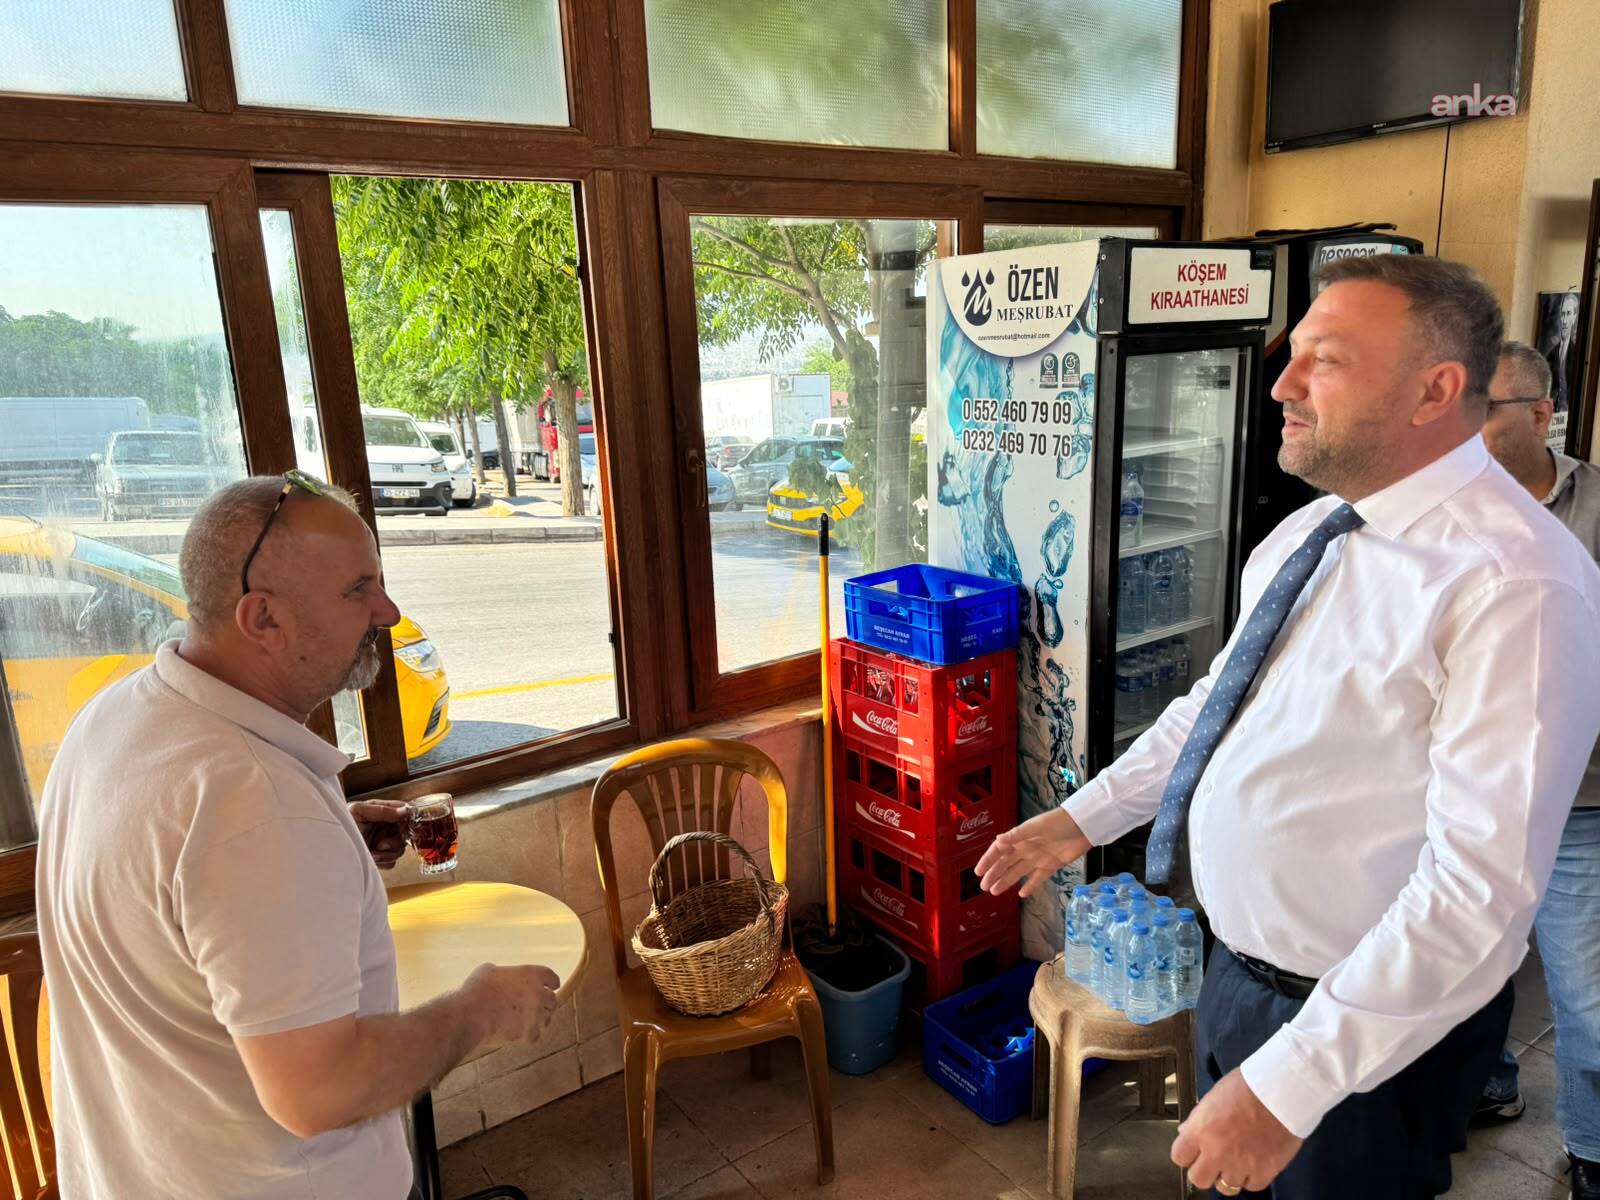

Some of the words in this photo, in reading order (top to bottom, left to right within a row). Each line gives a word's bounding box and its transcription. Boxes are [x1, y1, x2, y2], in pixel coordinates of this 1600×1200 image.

[1008, 264, 1059, 302] ÖZEN
[1177, 260, 1227, 286] KÖŞEM
[1151, 283, 1249, 310] KIRAATHANESİ
[996, 304, 1074, 323] MEŞRUBAT
[963, 399, 971, 421] 0
[973, 399, 998, 422] 552
[1001, 400, 1027, 423] 460
[1031, 401, 1049, 424] 79
[1052, 401, 1072, 425] 09
[963, 429, 995, 452] 0232
[998, 431, 1024, 454] 469
[1029, 433, 1047, 456] 70
[1052, 434, 1071, 457] 76
